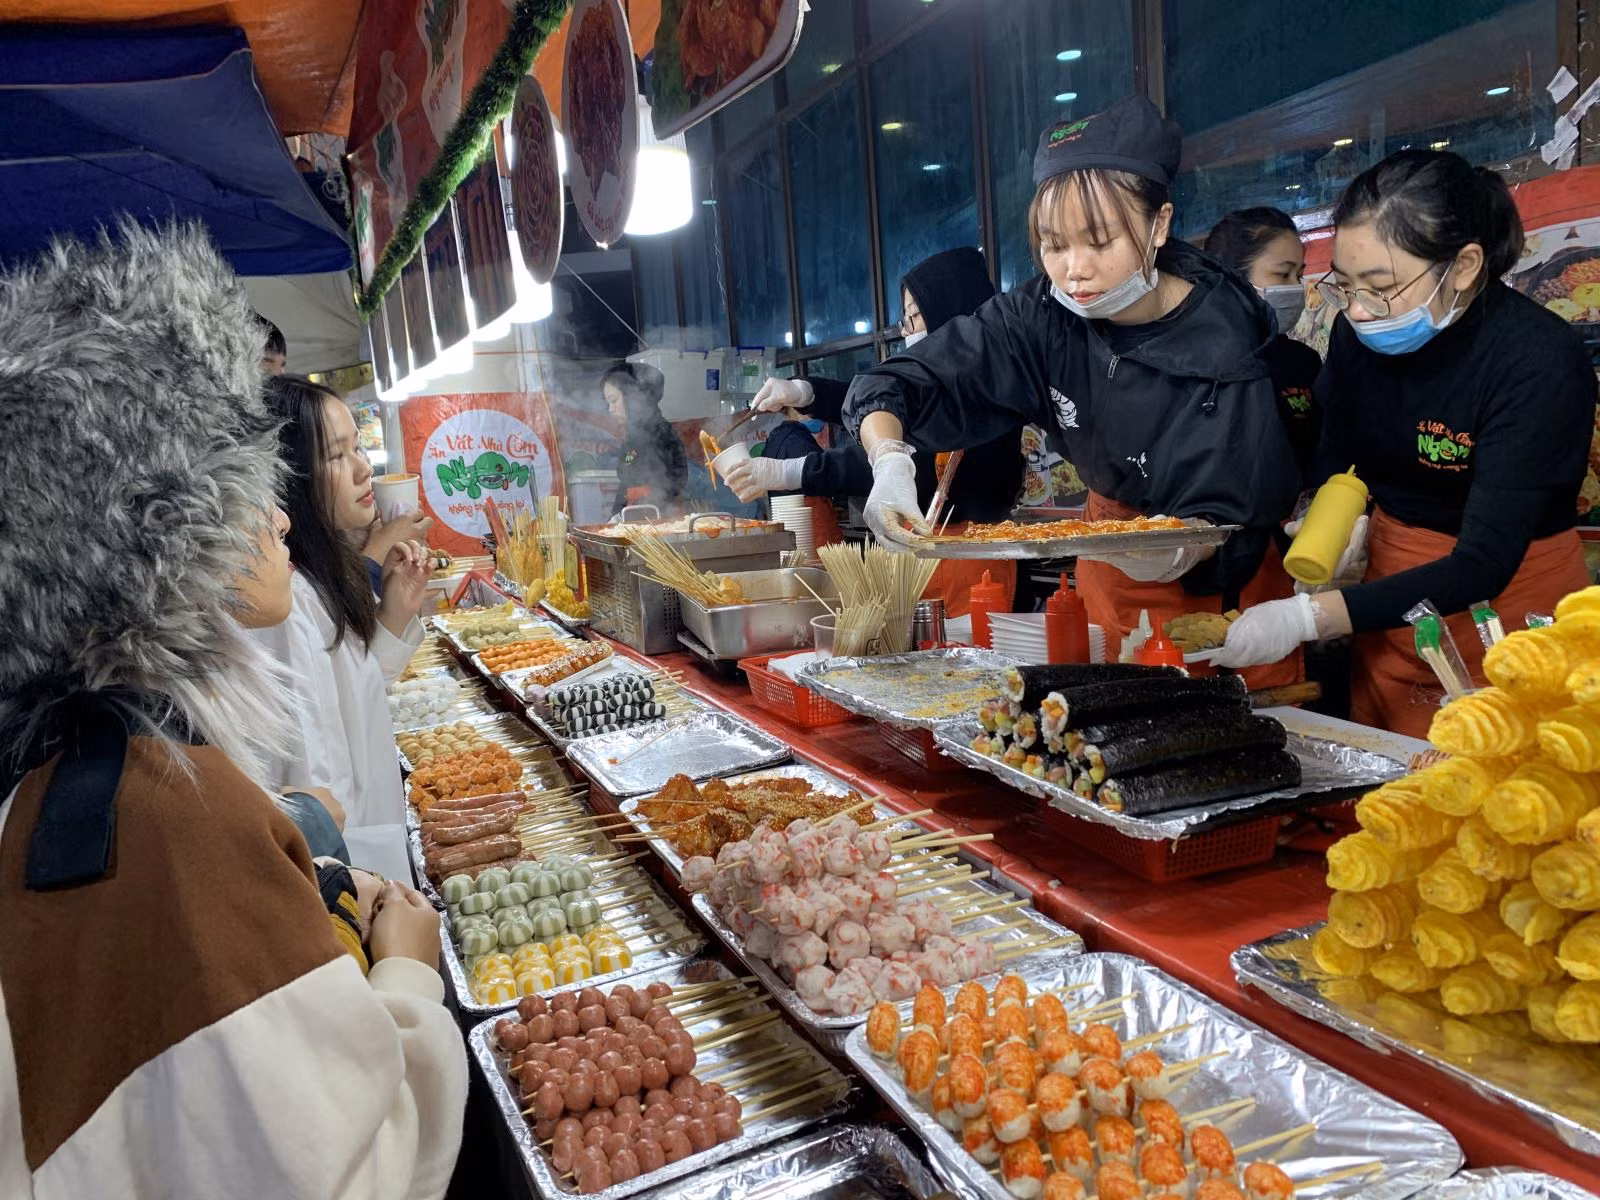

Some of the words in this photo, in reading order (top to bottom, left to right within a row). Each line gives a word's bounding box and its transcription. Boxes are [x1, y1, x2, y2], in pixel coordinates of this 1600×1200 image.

[428, 442, 446, 459] Ăn
[445, 433, 474, 454] Vặt
[448, 503, 473, 517] không
